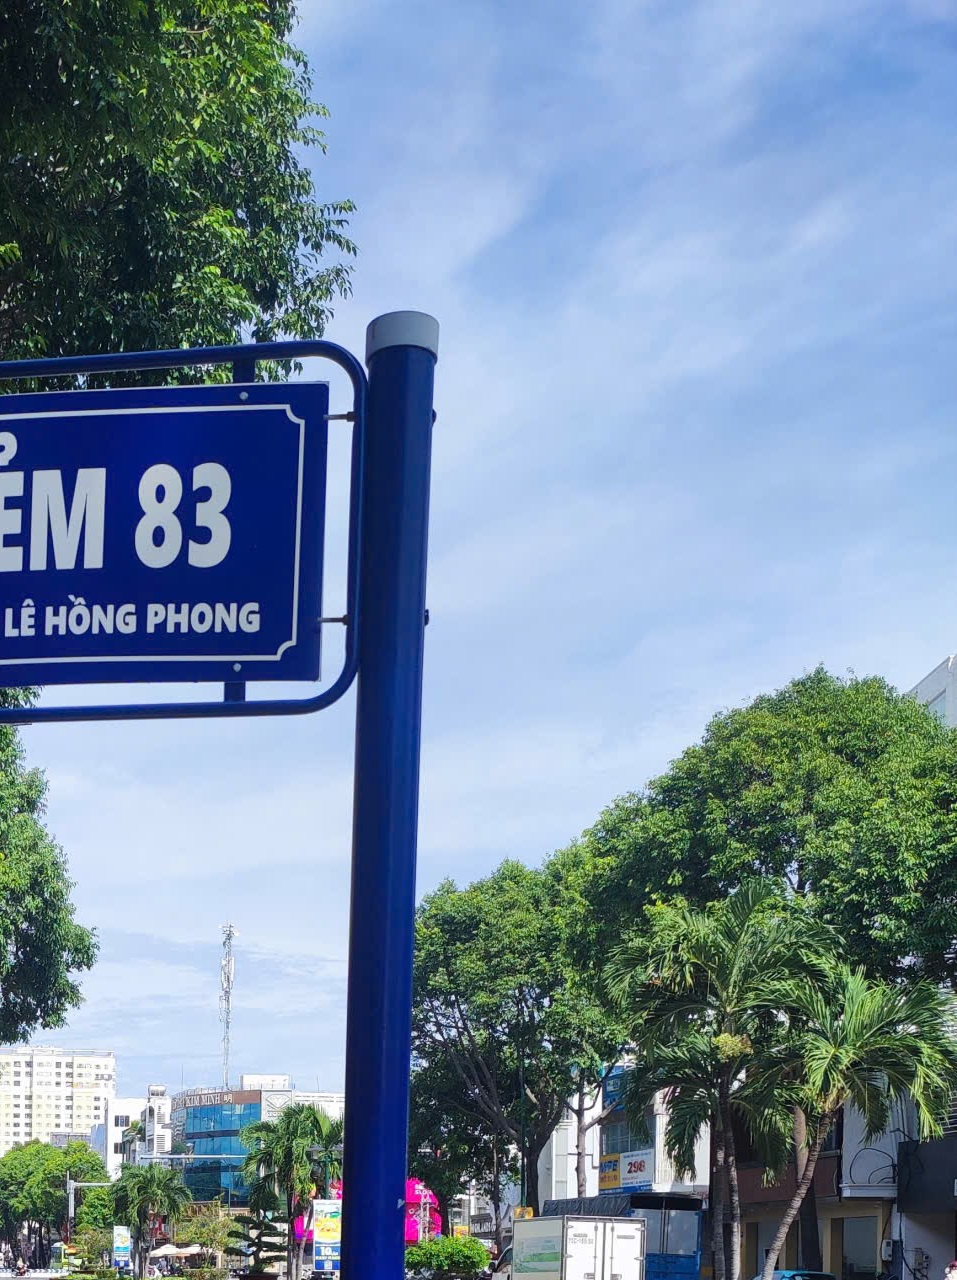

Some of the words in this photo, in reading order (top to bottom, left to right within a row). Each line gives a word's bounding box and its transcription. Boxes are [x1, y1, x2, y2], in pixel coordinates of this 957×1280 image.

[134, 462, 232, 569] 83
[4, 598, 36, 638] LÊ
[44, 594, 138, 636] HỒNG
[146, 602, 261, 635] PHONG
